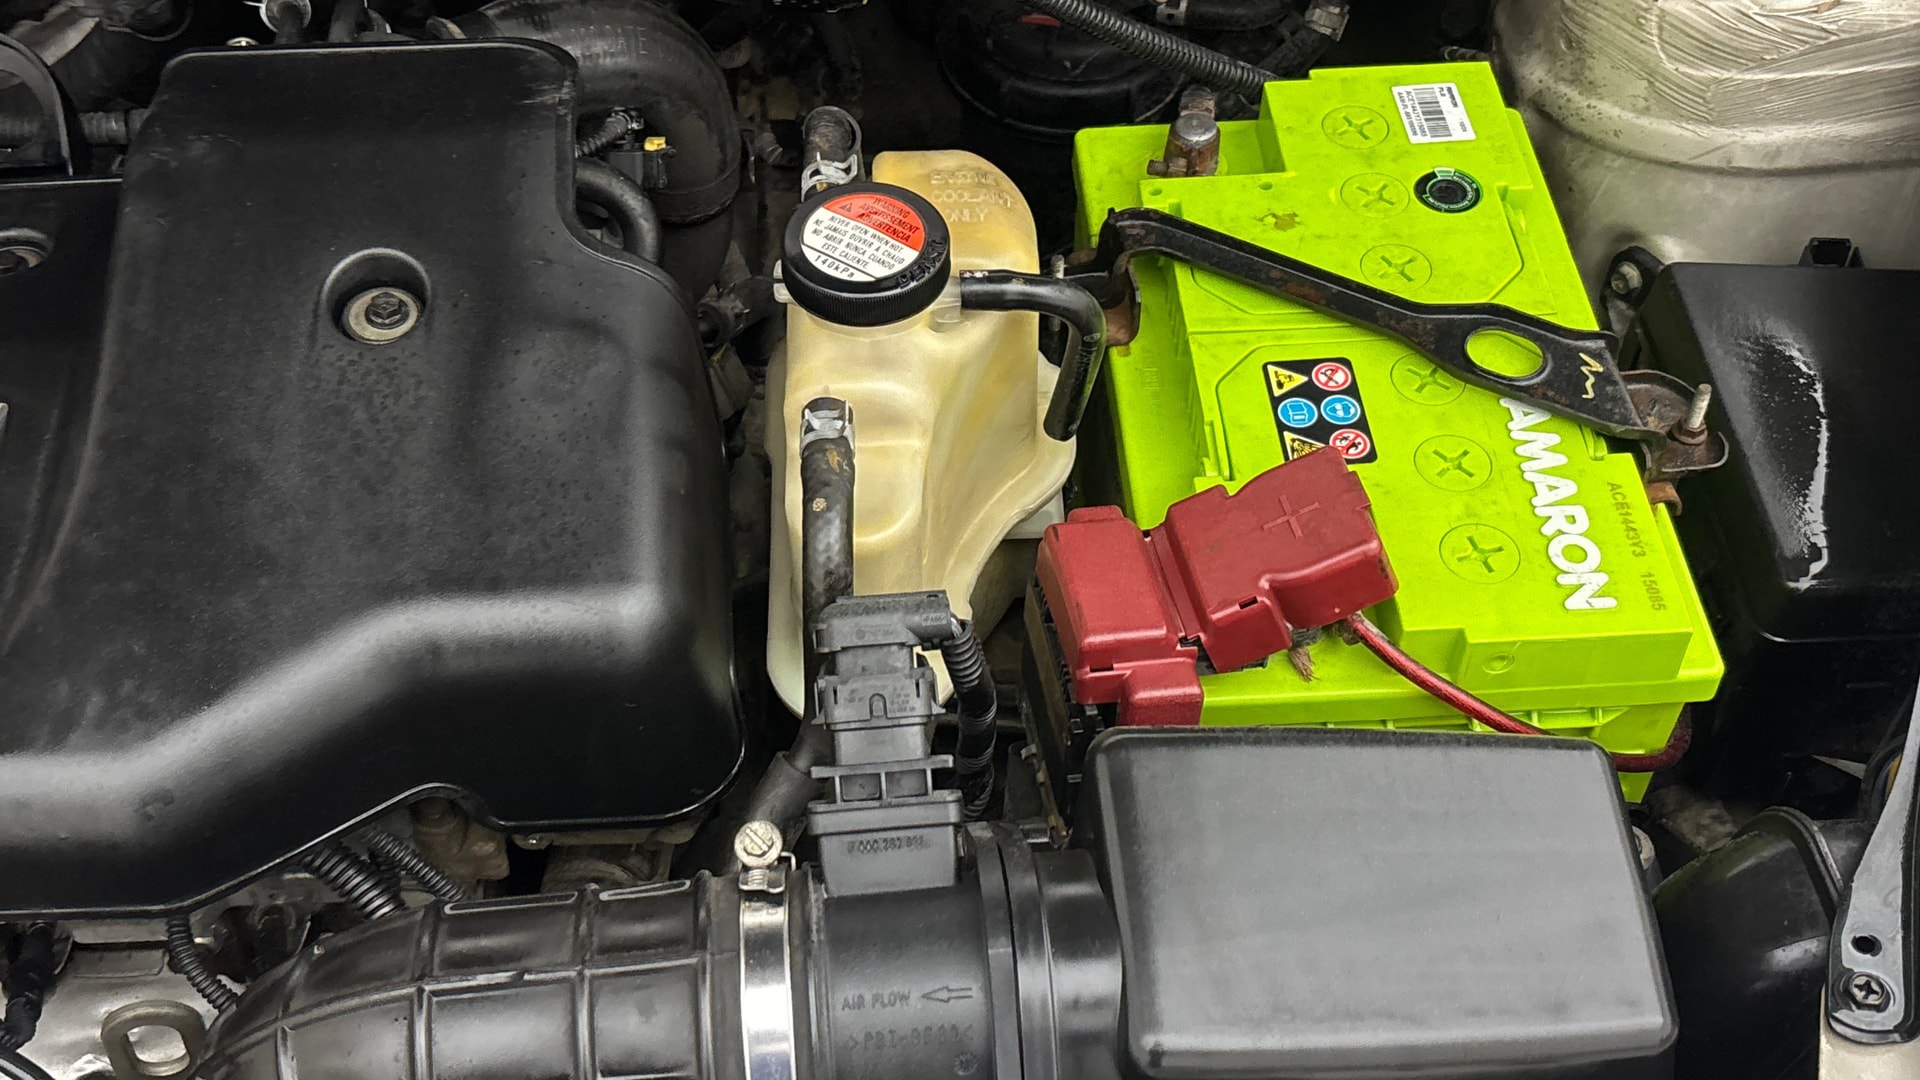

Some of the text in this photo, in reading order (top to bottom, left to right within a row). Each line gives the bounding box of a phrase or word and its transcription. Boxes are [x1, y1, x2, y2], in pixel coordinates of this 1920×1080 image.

[859, 203, 920, 234] AVERTISSEMENT
[874, 197, 910, 219] WARNING
[812, 218, 824, 227] NE
[824, 224, 848, 237] JAMAIS
[849, 233, 874, 248] OUVRIR
[881, 249, 905, 264] CHAUD
[828, 215, 850, 228] NEVER
[851, 224, 870, 236] OPEN
[870, 231, 891, 246] WHEN
[856, 212, 911, 242] ADVERTENCIA
[811, 228, 896, 270] NO ABRIR NUNCA CUANDO
[821, 243, 839, 254] ESTE
[814, 255, 855, 279] 140kPa
[1499, 397, 1618, 610] AMARON
[1606, 481, 1647, 559] ACE1443Y3
[1640, 571, 1667, 612] 15085
[842, 990, 911, 1011] AIR FLOW
